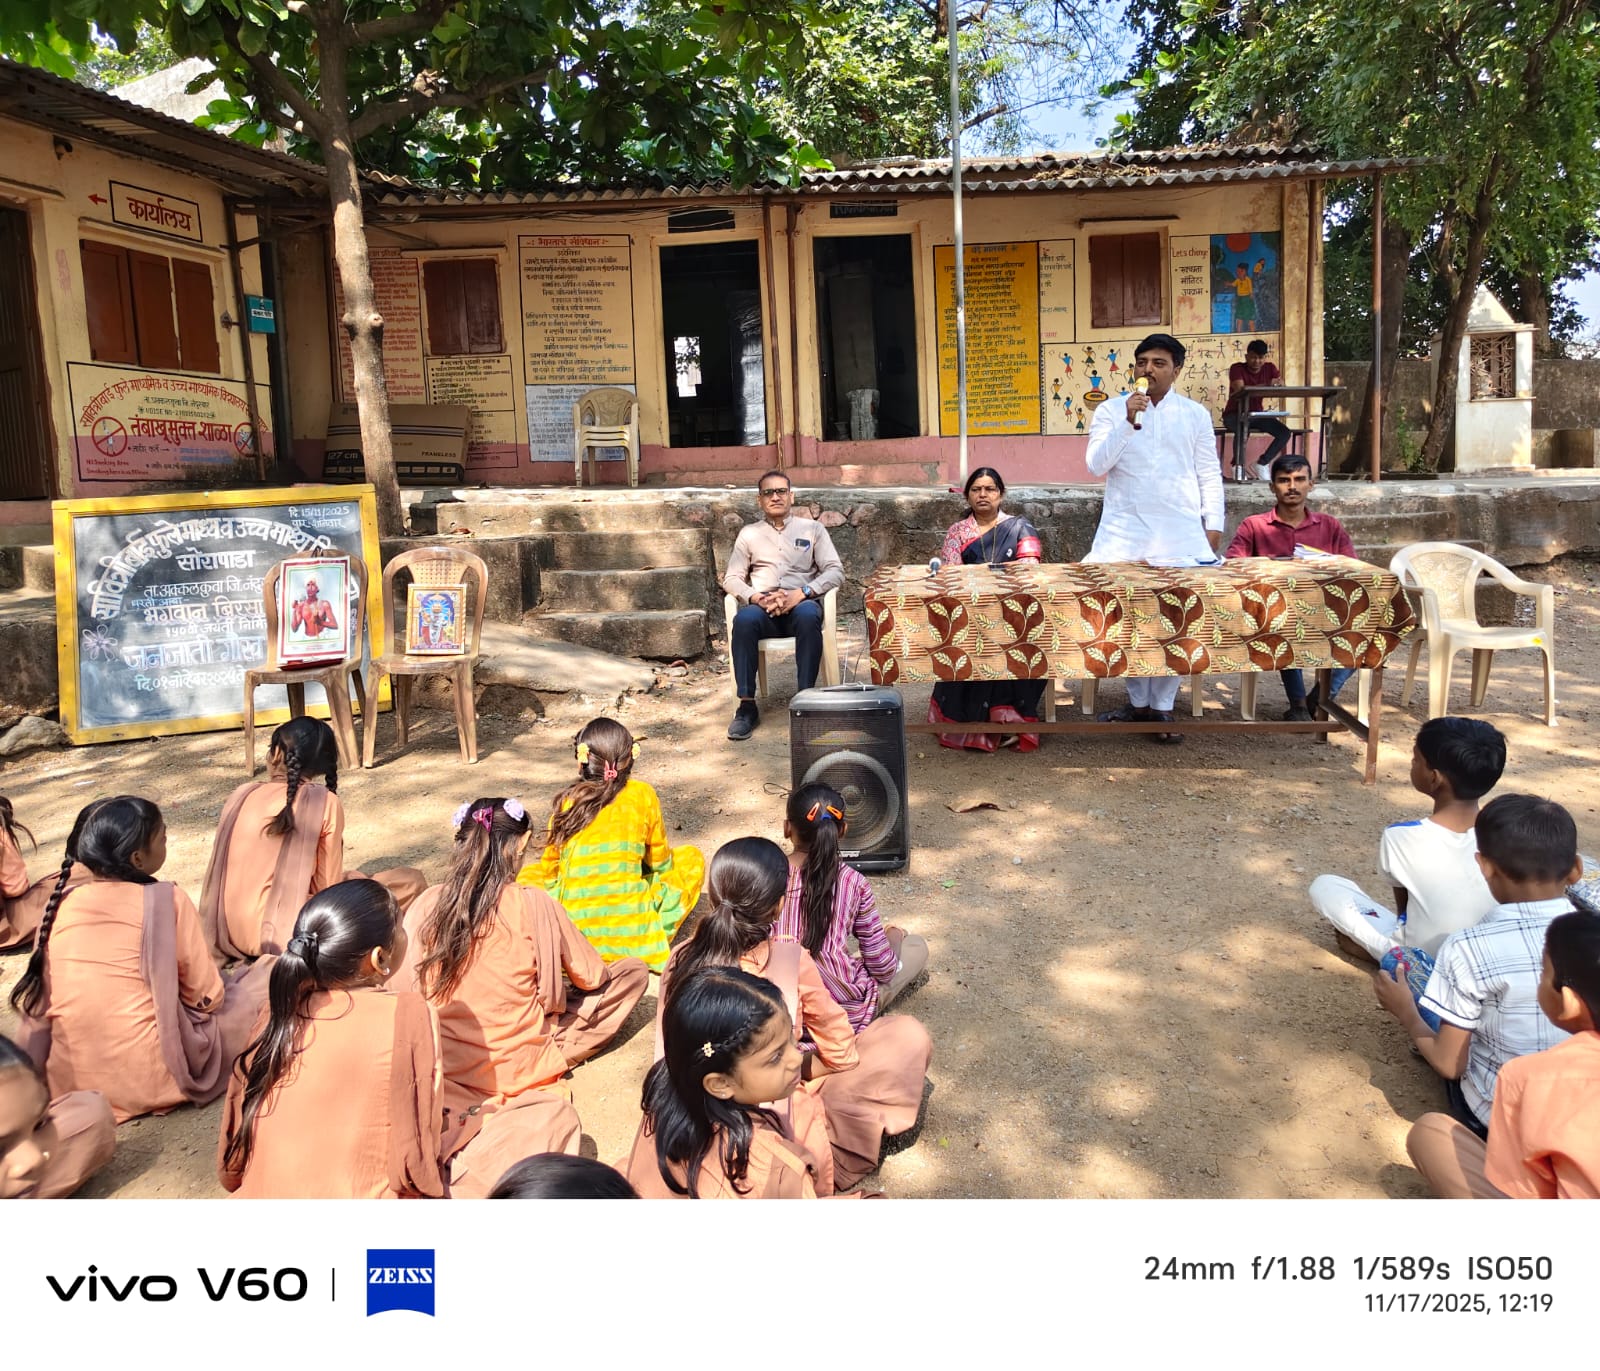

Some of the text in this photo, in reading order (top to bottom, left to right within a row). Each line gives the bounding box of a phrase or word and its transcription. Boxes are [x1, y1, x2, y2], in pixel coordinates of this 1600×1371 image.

[126, 196, 192, 231] कार्यालय
[1179, 265, 1203, 275] स्वच्छता
[1180, 275, 1203, 286] मॉनिटर
[1181, 287, 1203, 297] उपक्रम
[80, 382, 116, 427] सावित्रीबाई
[112, 377, 130, 401] फुले
[129, 375, 162, 391] माध्यमिक
[162, 378, 169, 391] व
[169, 379, 188, 393] उच्च
[188, 382, 220, 398] माध्यमिक
[128, 414, 233, 446] तंबाखूमुक्त शाळा
[421, 451, 457, 459] FRAMELESS
[301, 505, 350, 517] 15/11/2025
[144, 519, 185, 560] फुले
[175, 546, 255, 571] सोरापाडा
[143, 595, 265, 625] भगवान बिरसा
[200, 616, 234, 634] जयंती
[120, 633, 214, 671] जनजाती
